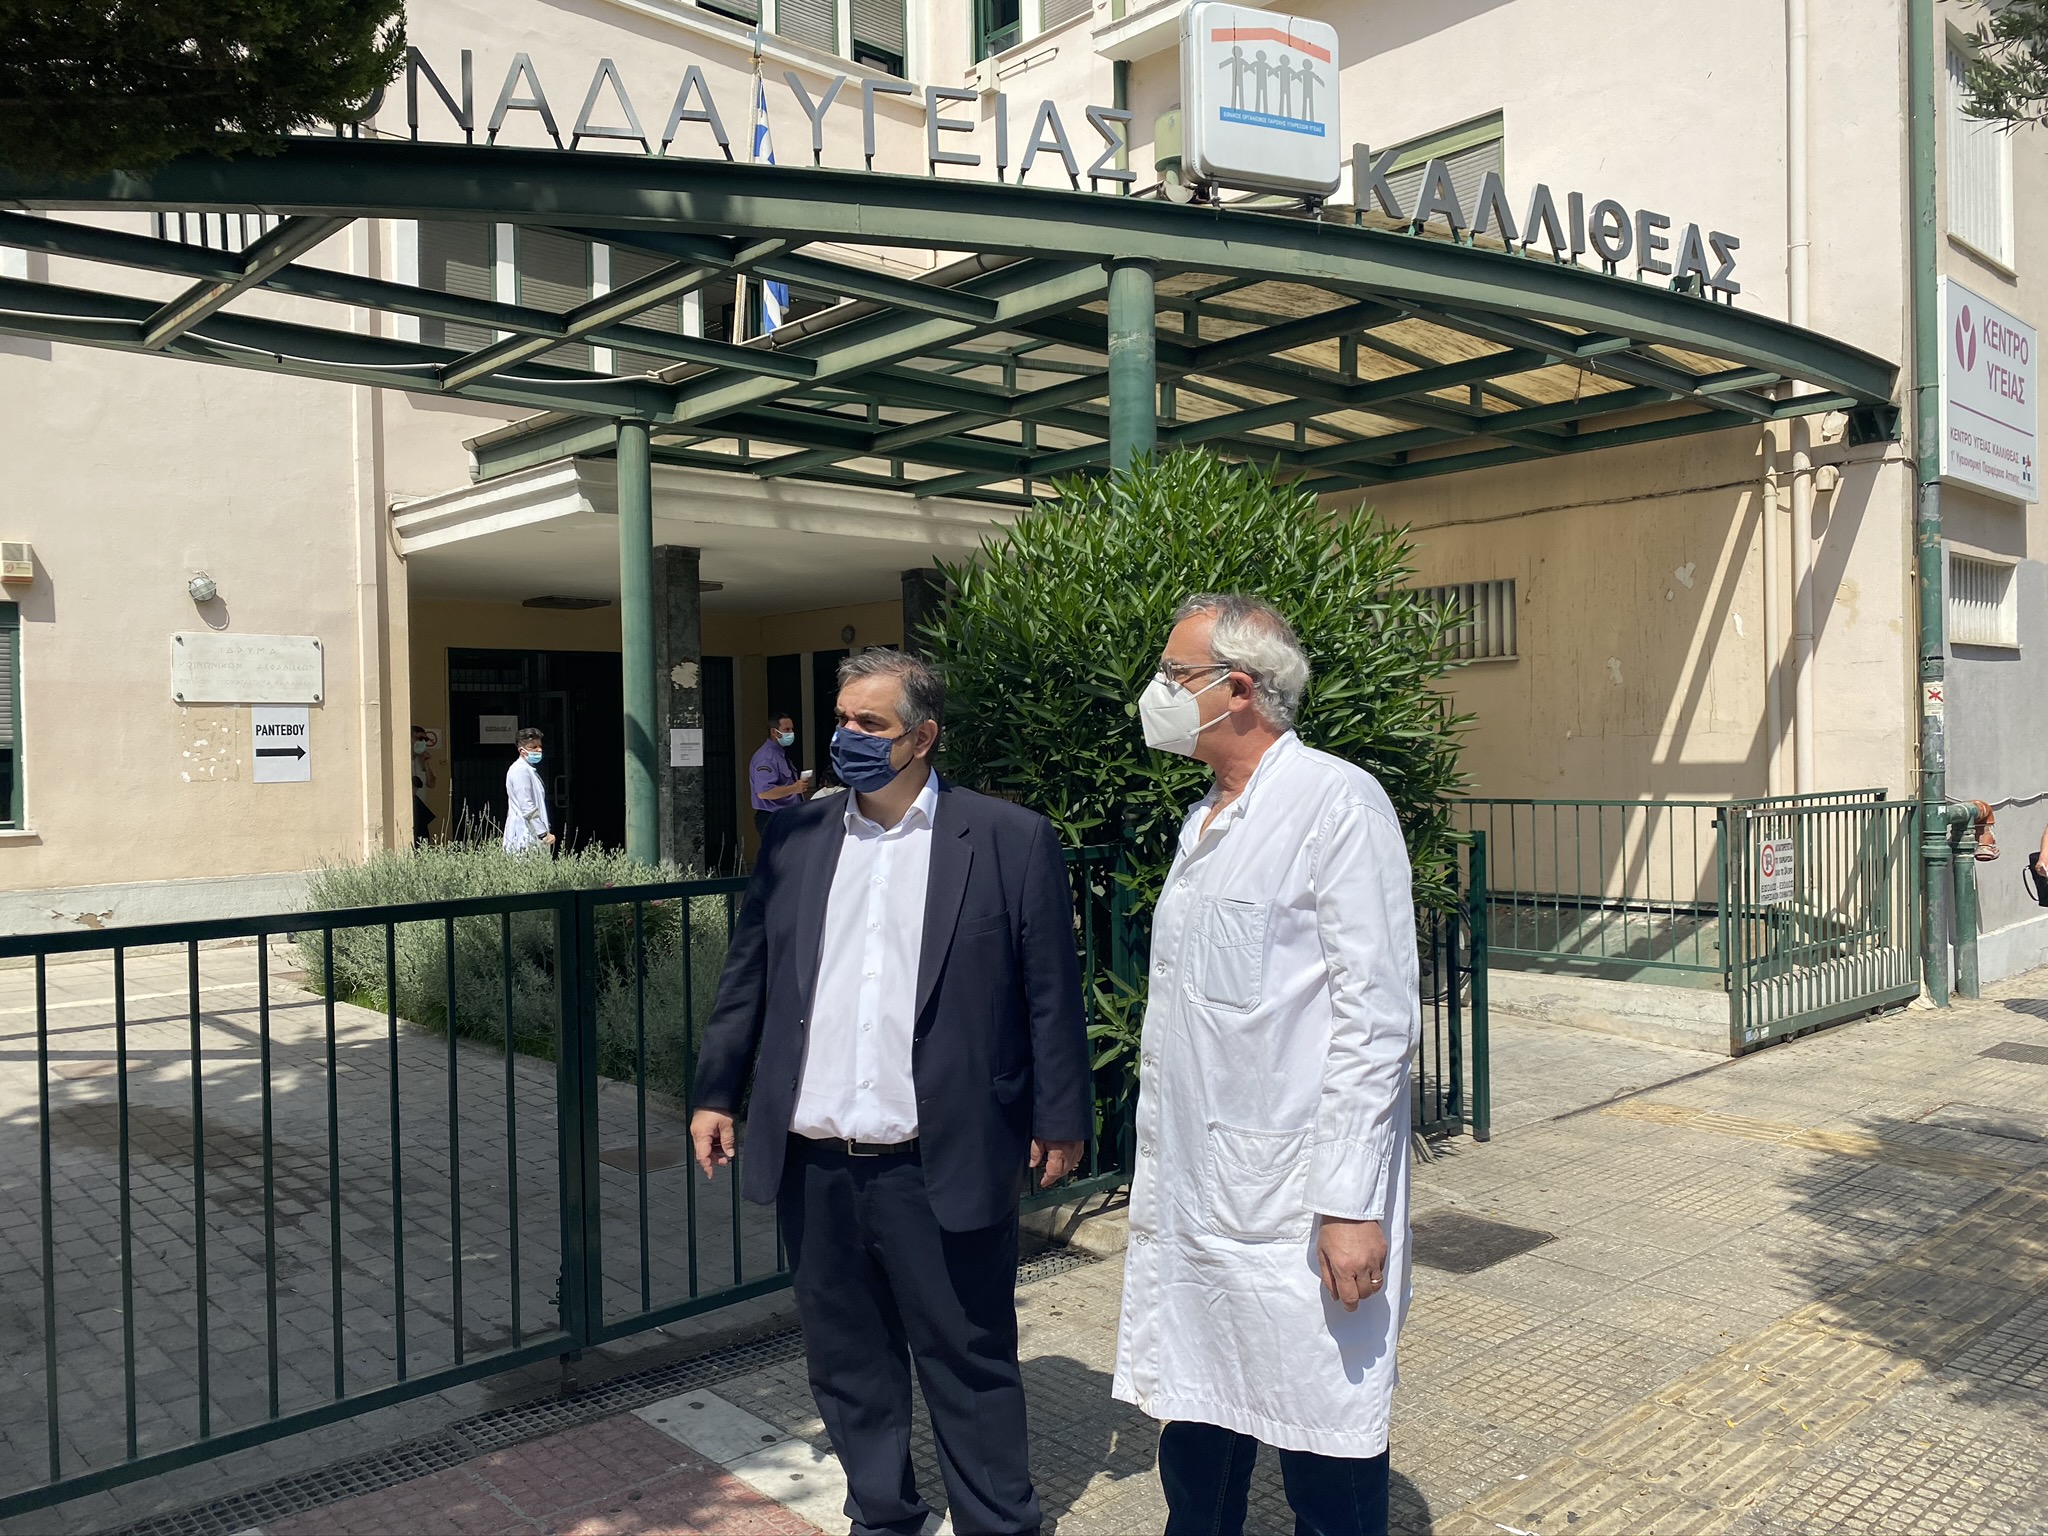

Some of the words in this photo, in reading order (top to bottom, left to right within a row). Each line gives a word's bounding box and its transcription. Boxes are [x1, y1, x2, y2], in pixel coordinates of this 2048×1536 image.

[784, 70, 1137, 181] ΥΓΕΙΑΣ
[1352, 142, 1740, 295] ΚΑΛΛΙΘΕΑΣ
[1983, 315, 2029, 366] ΚΕΝΤΡΟ
[1987, 360, 2025, 405] ΥΓΕΙΑΣ
[1950, 427, 1972, 446] ΚΕΝΤΡΟ
[1973, 435, 1991, 454] ΥΓΕΙΑΣ
[255, 724, 305, 736] ΡΑΝΤΕΒΟΥ
